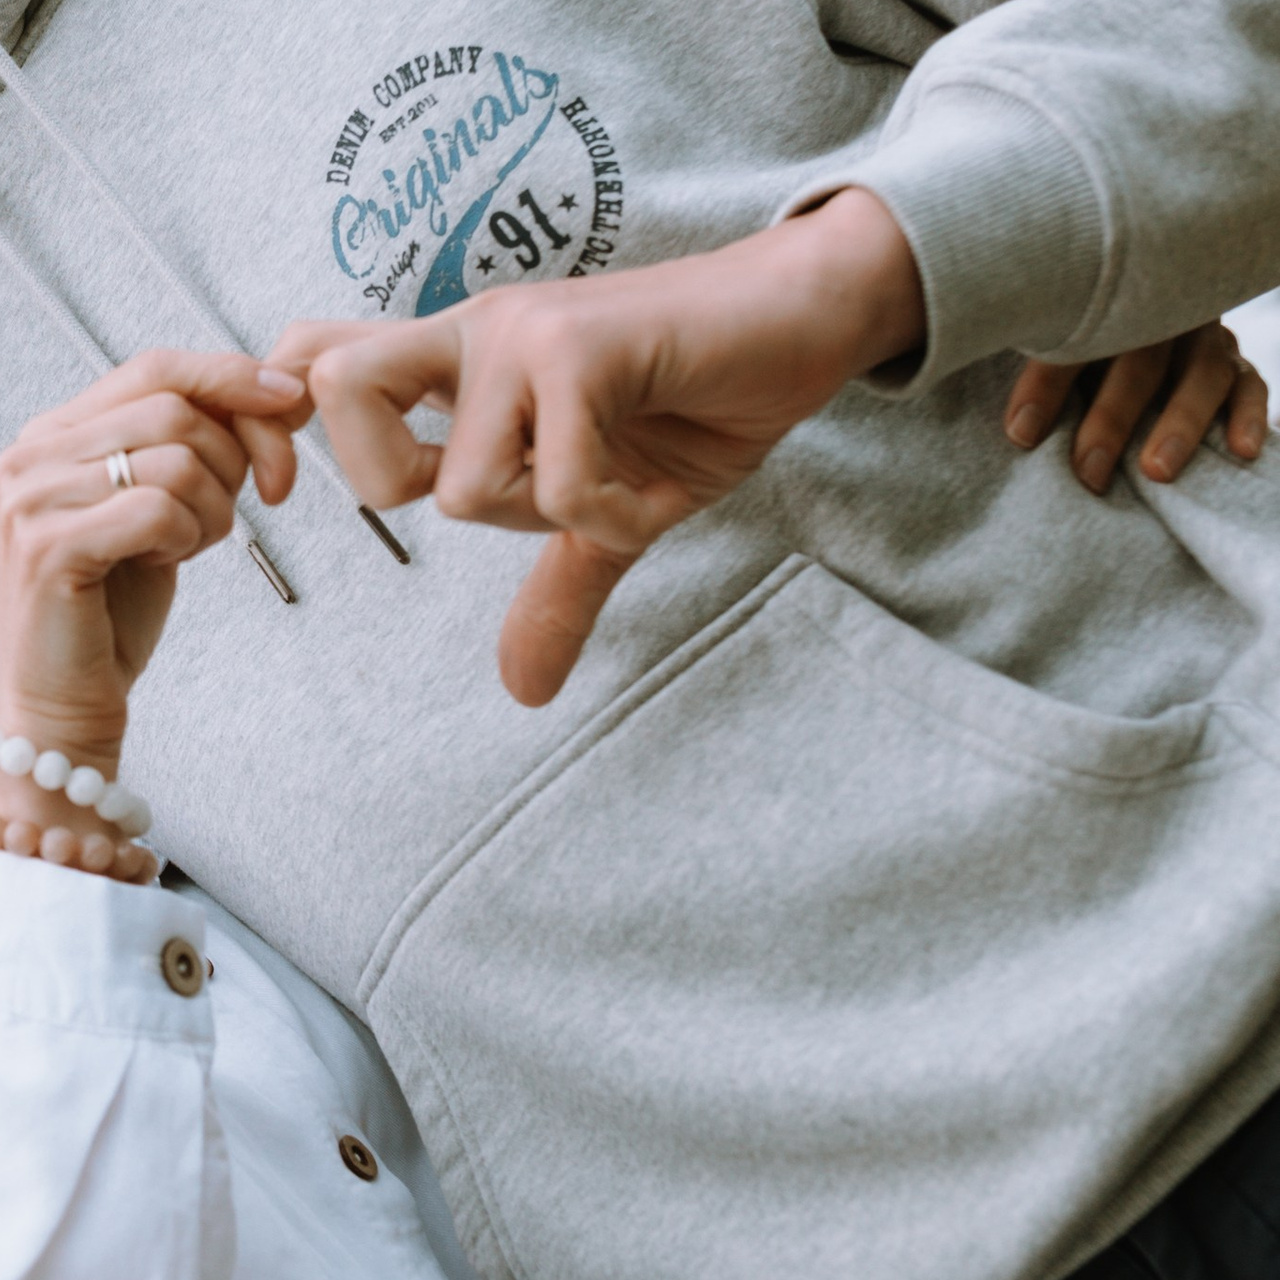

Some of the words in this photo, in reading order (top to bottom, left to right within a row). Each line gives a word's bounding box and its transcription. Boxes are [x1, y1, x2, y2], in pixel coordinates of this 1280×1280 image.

[326, 107, 375, 186] DENIM
[372, 46, 483, 108] COMPANY
[559, 96, 621, 178] NORTH
[332, 51, 559, 280] Originals
[489, 188, 571, 271] 91
[363, 239, 421, 312] Design
